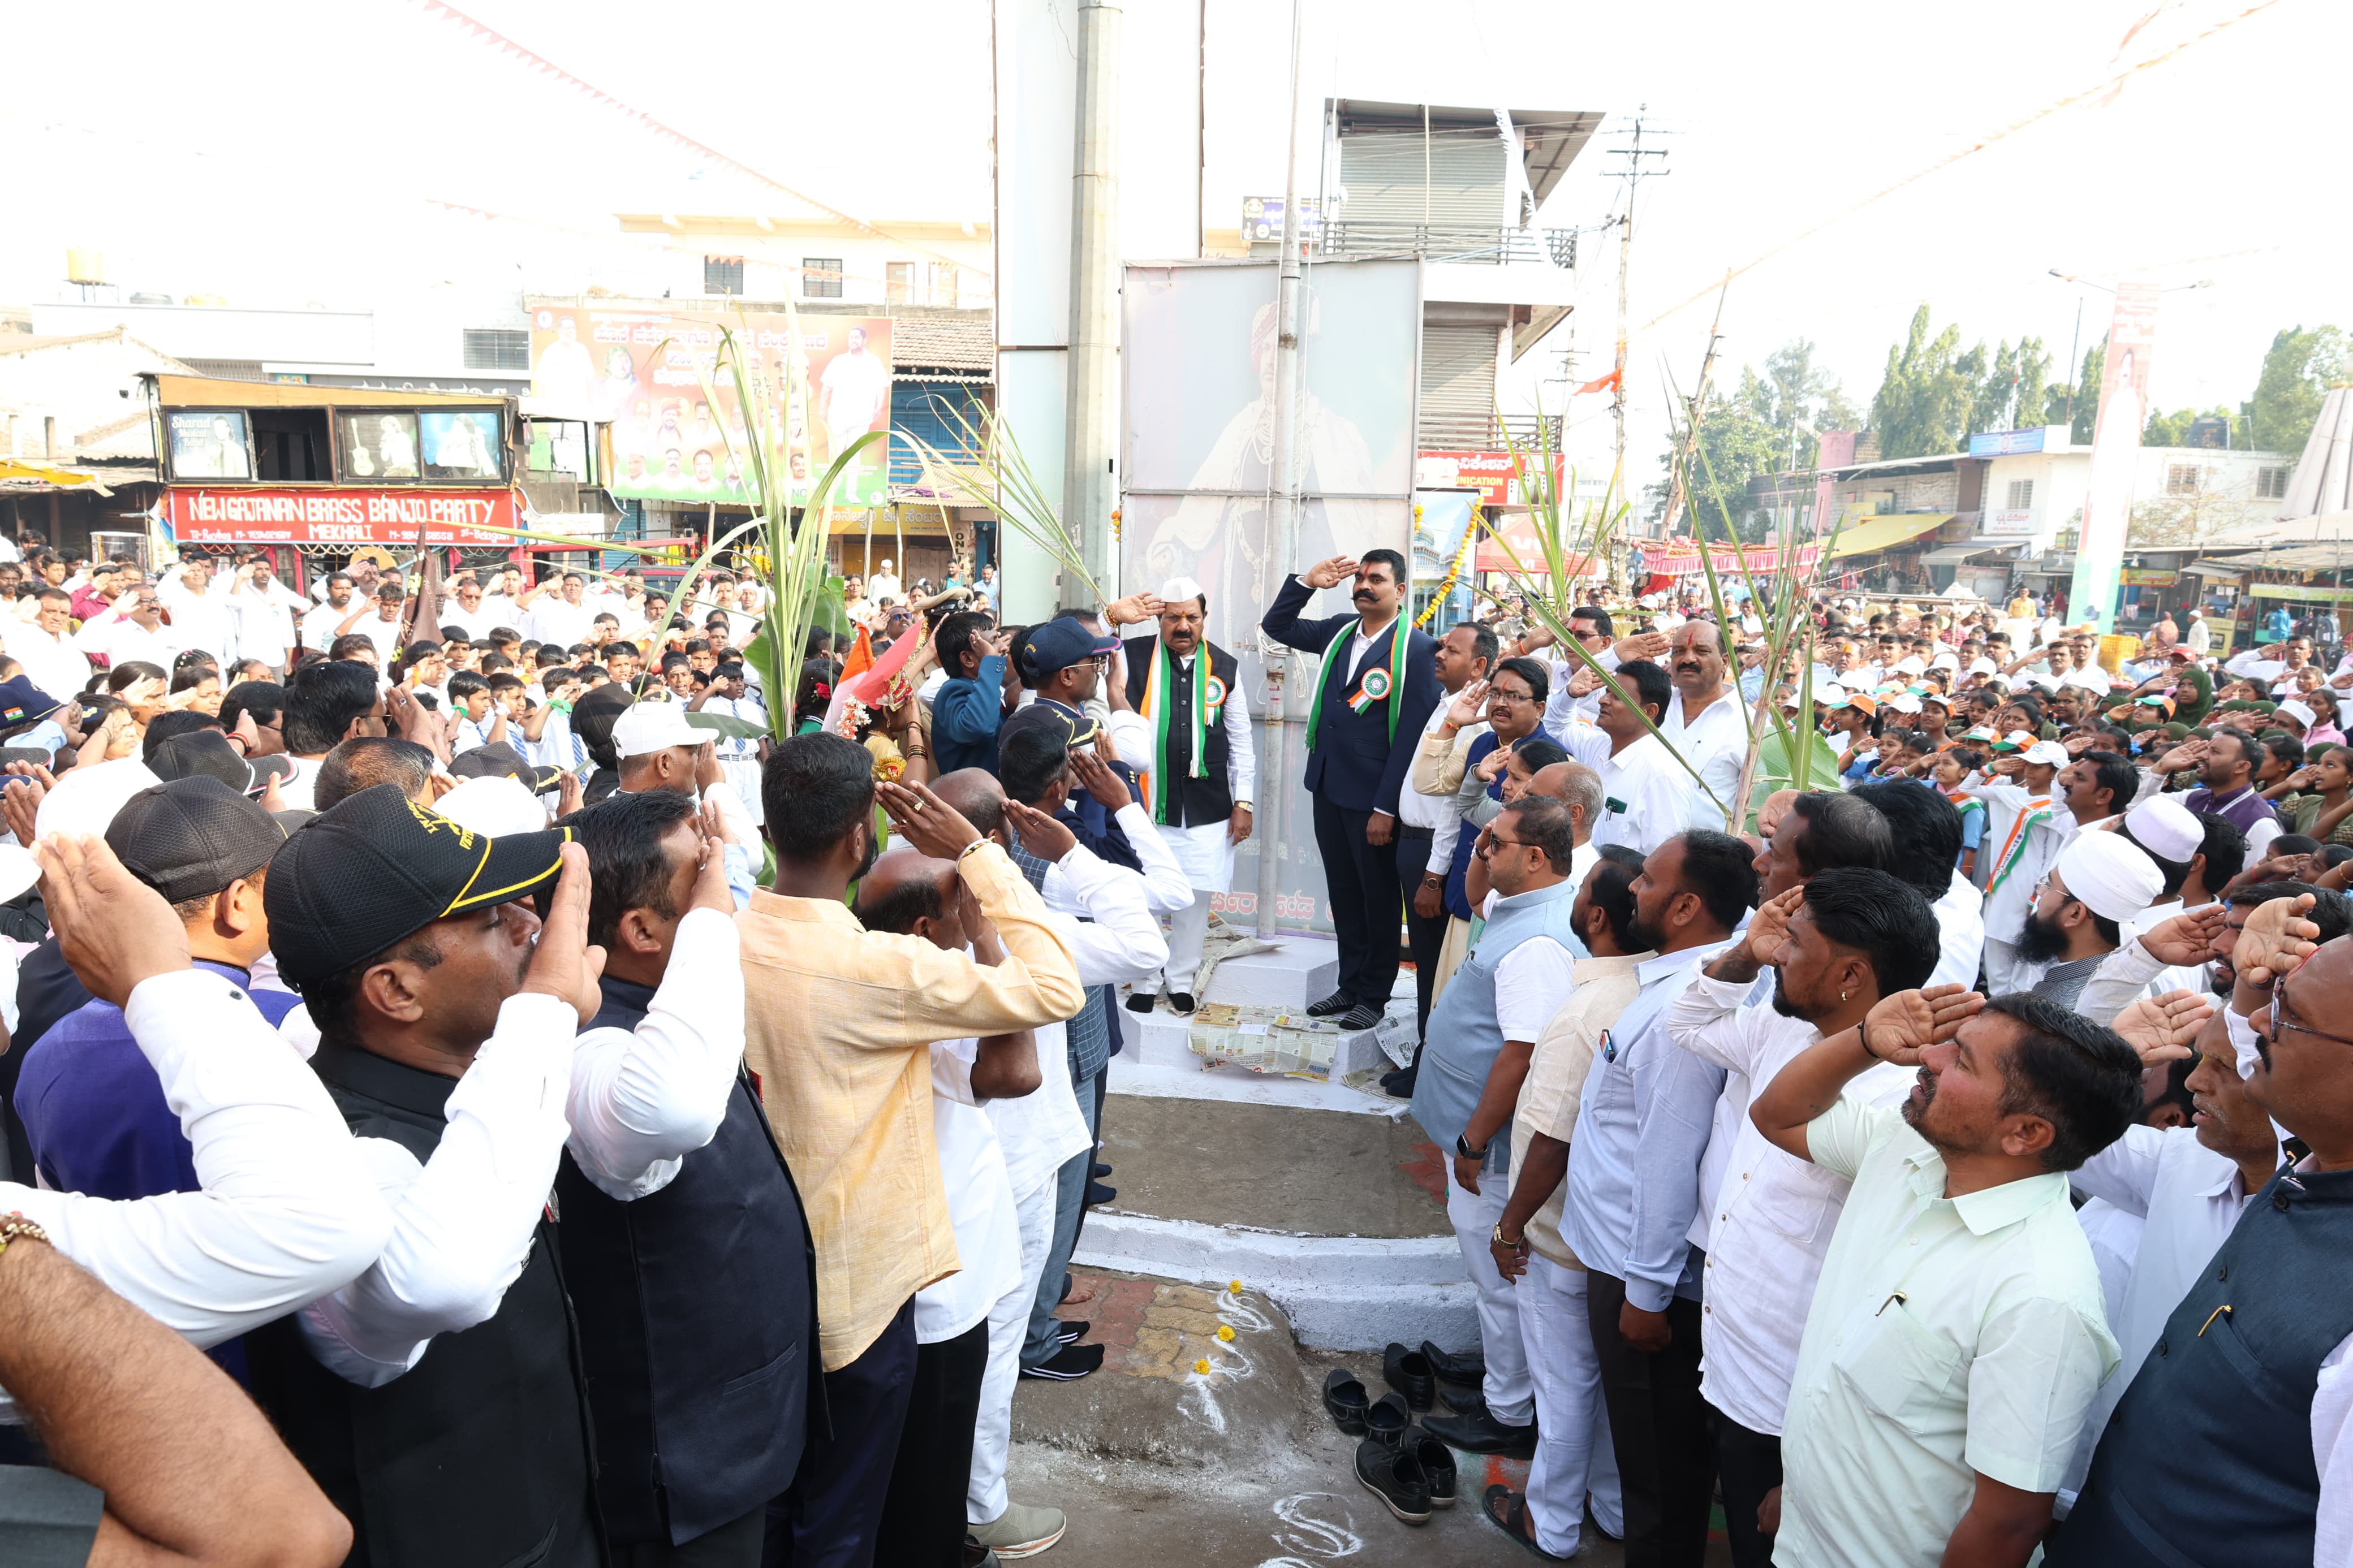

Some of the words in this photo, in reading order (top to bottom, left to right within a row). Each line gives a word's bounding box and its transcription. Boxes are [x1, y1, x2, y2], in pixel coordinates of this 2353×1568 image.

[172, 416, 210, 429] Sharad
[188, 497, 226, 521] NEW
[227, 497, 303, 522] GAJANAN
[306, 498, 364, 524] BRASS
[368, 498, 426, 524] BANJO
[430, 499, 495, 524] PARTY
[308, 524, 373, 540] MEKHALI
